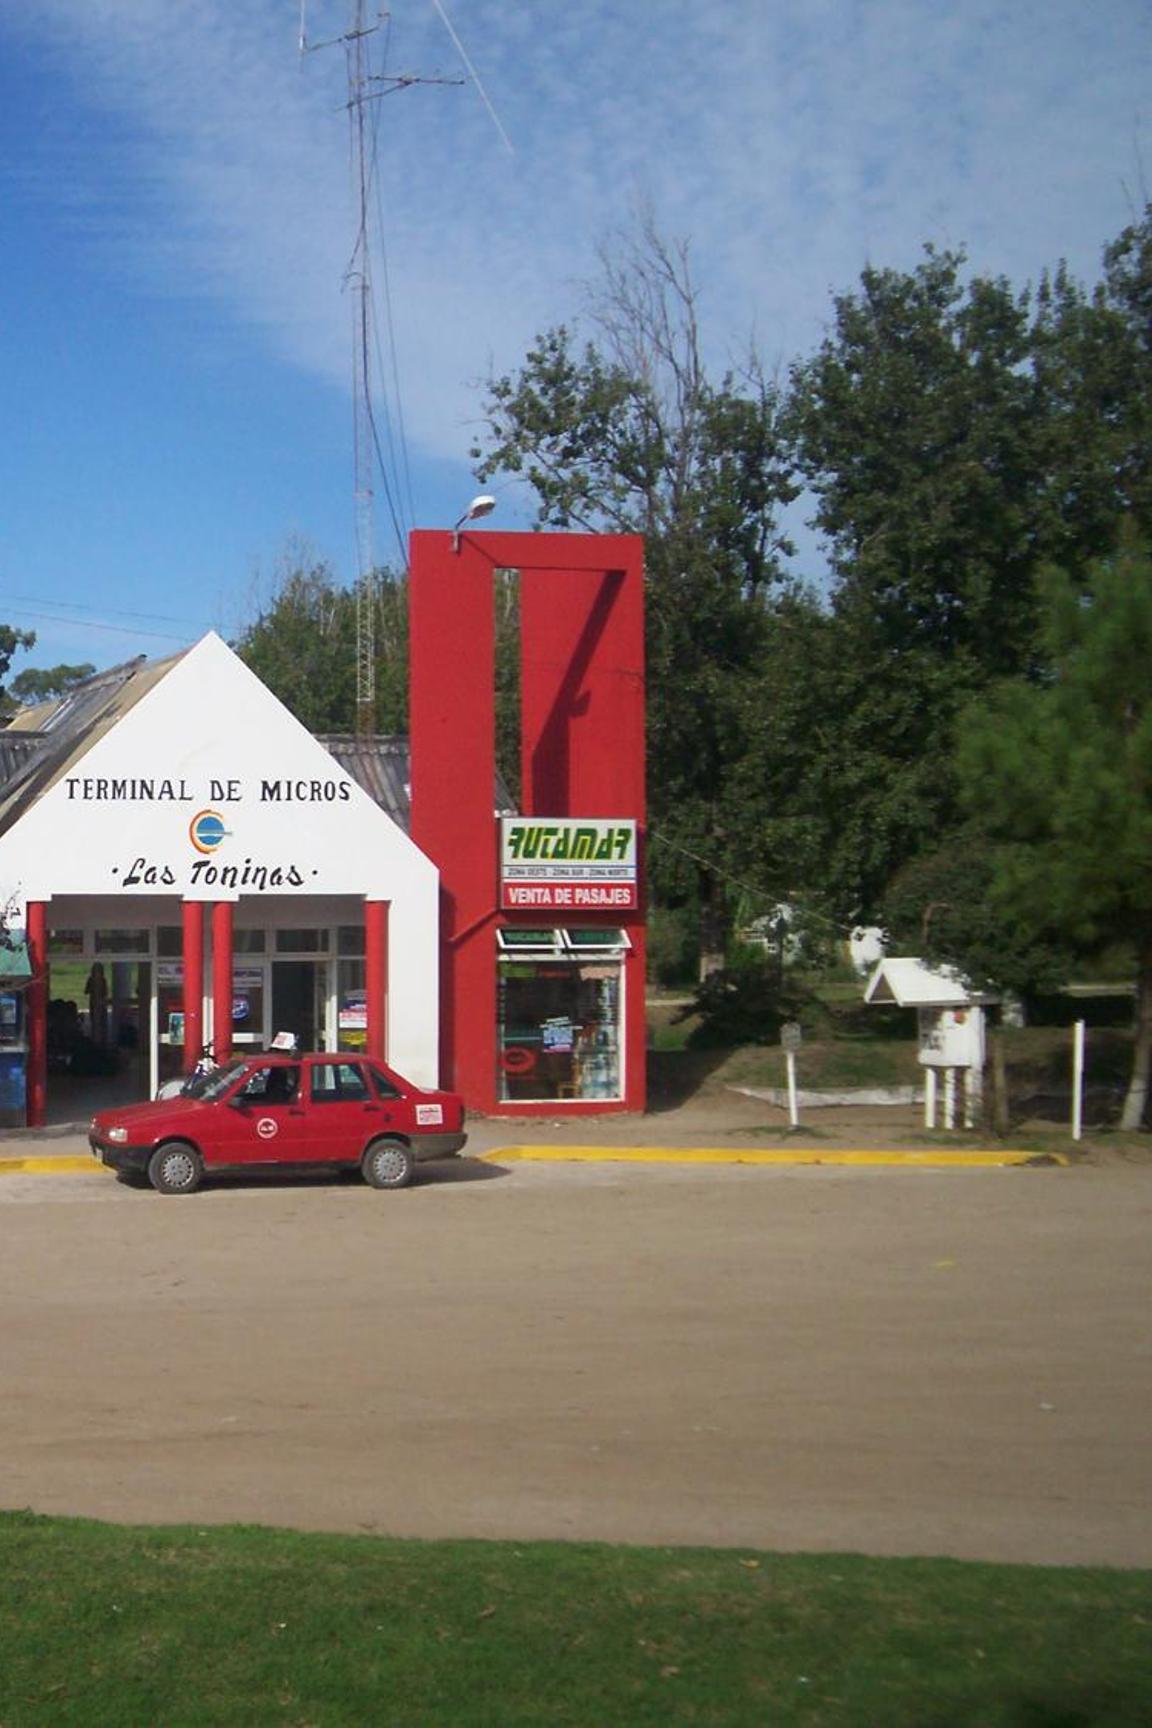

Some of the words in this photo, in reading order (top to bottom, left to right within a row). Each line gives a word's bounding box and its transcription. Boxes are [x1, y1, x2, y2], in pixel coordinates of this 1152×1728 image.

[66, 778, 193, 801] TERMINAL
[210, 779, 242, 801] DE
[260, 780, 351, 802] MICROS
[122, 858, 176, 888] Las
[190, 858, 305, 890] Toninas
[508, 888, 551, 904] VENTA
[554, 888, 572, 904] DE
[575, 888, 631, 904] PASAJES
